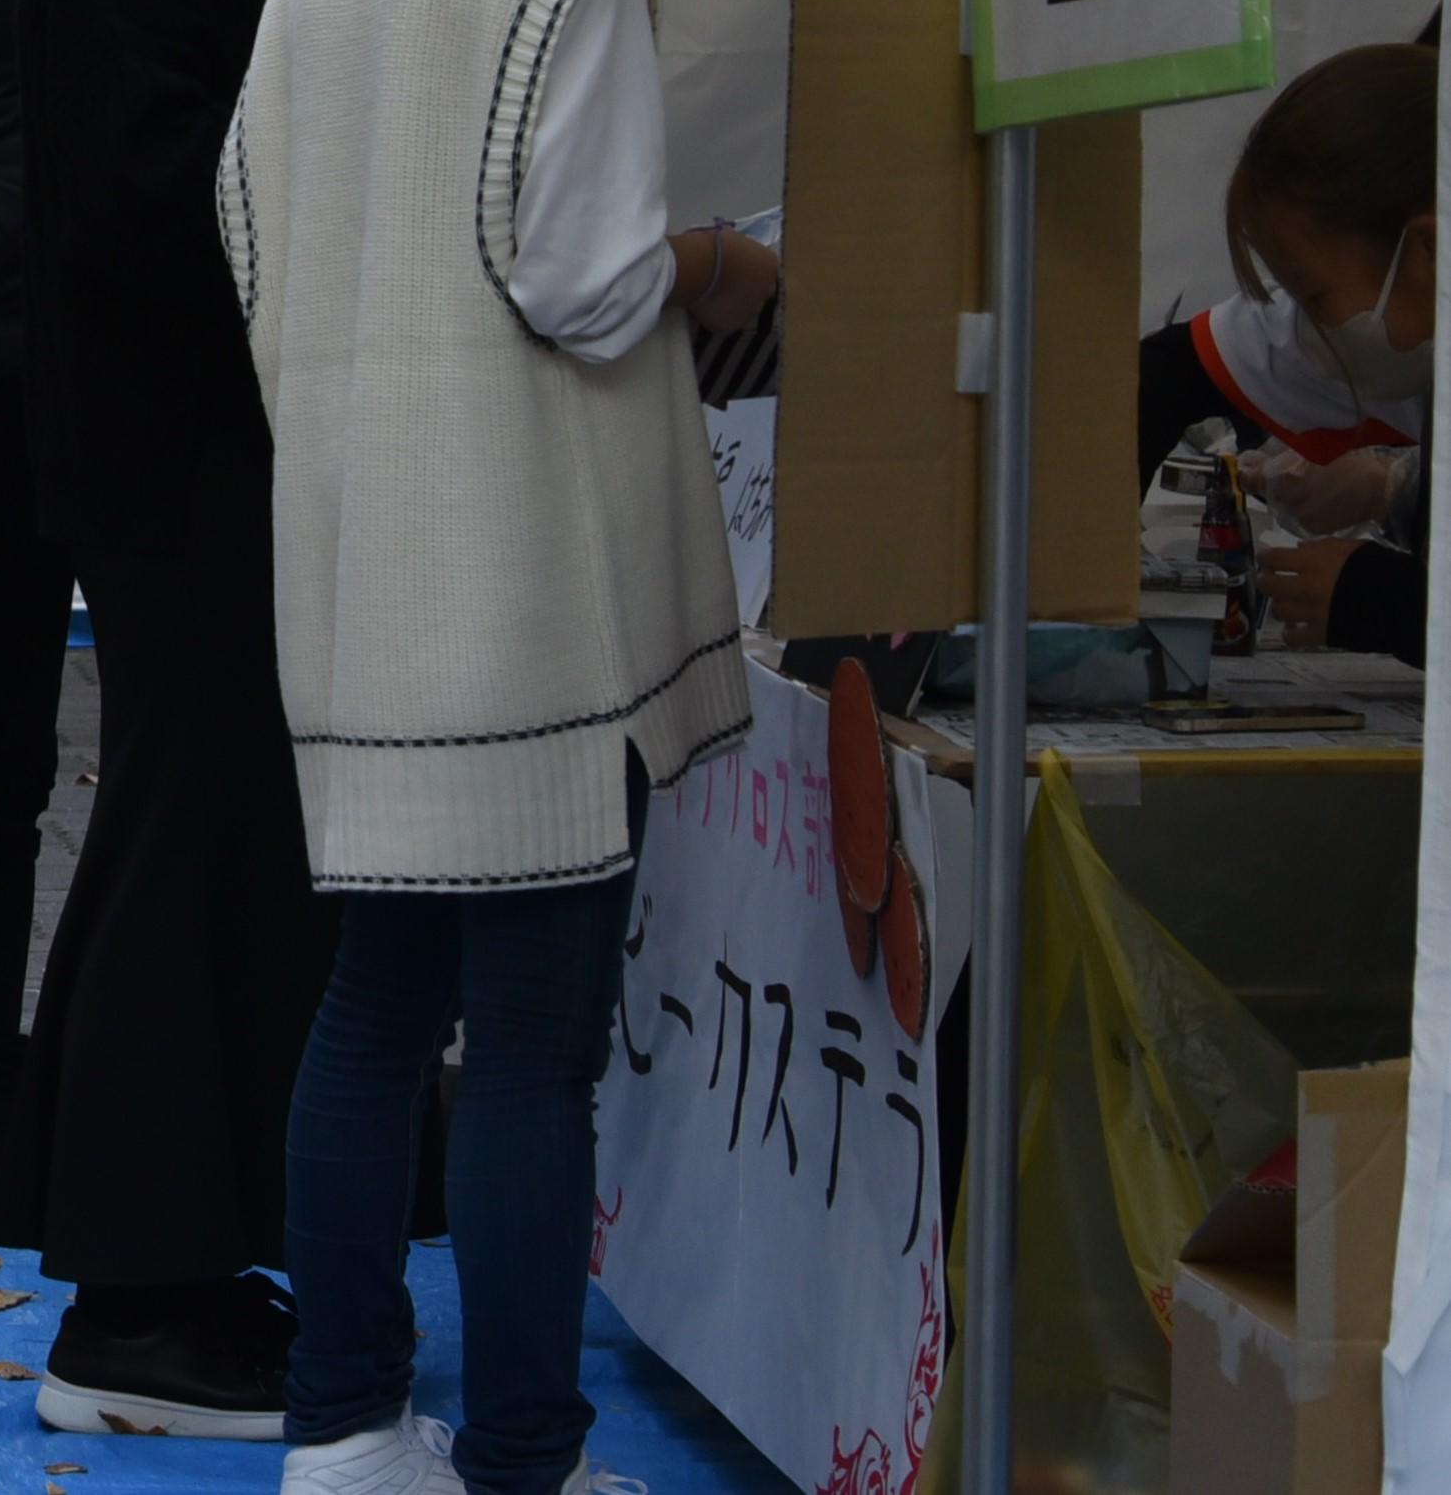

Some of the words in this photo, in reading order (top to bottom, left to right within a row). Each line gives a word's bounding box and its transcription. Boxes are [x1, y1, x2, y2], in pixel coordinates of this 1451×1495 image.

[609, 893, 925, 1259] ビーカステラ
